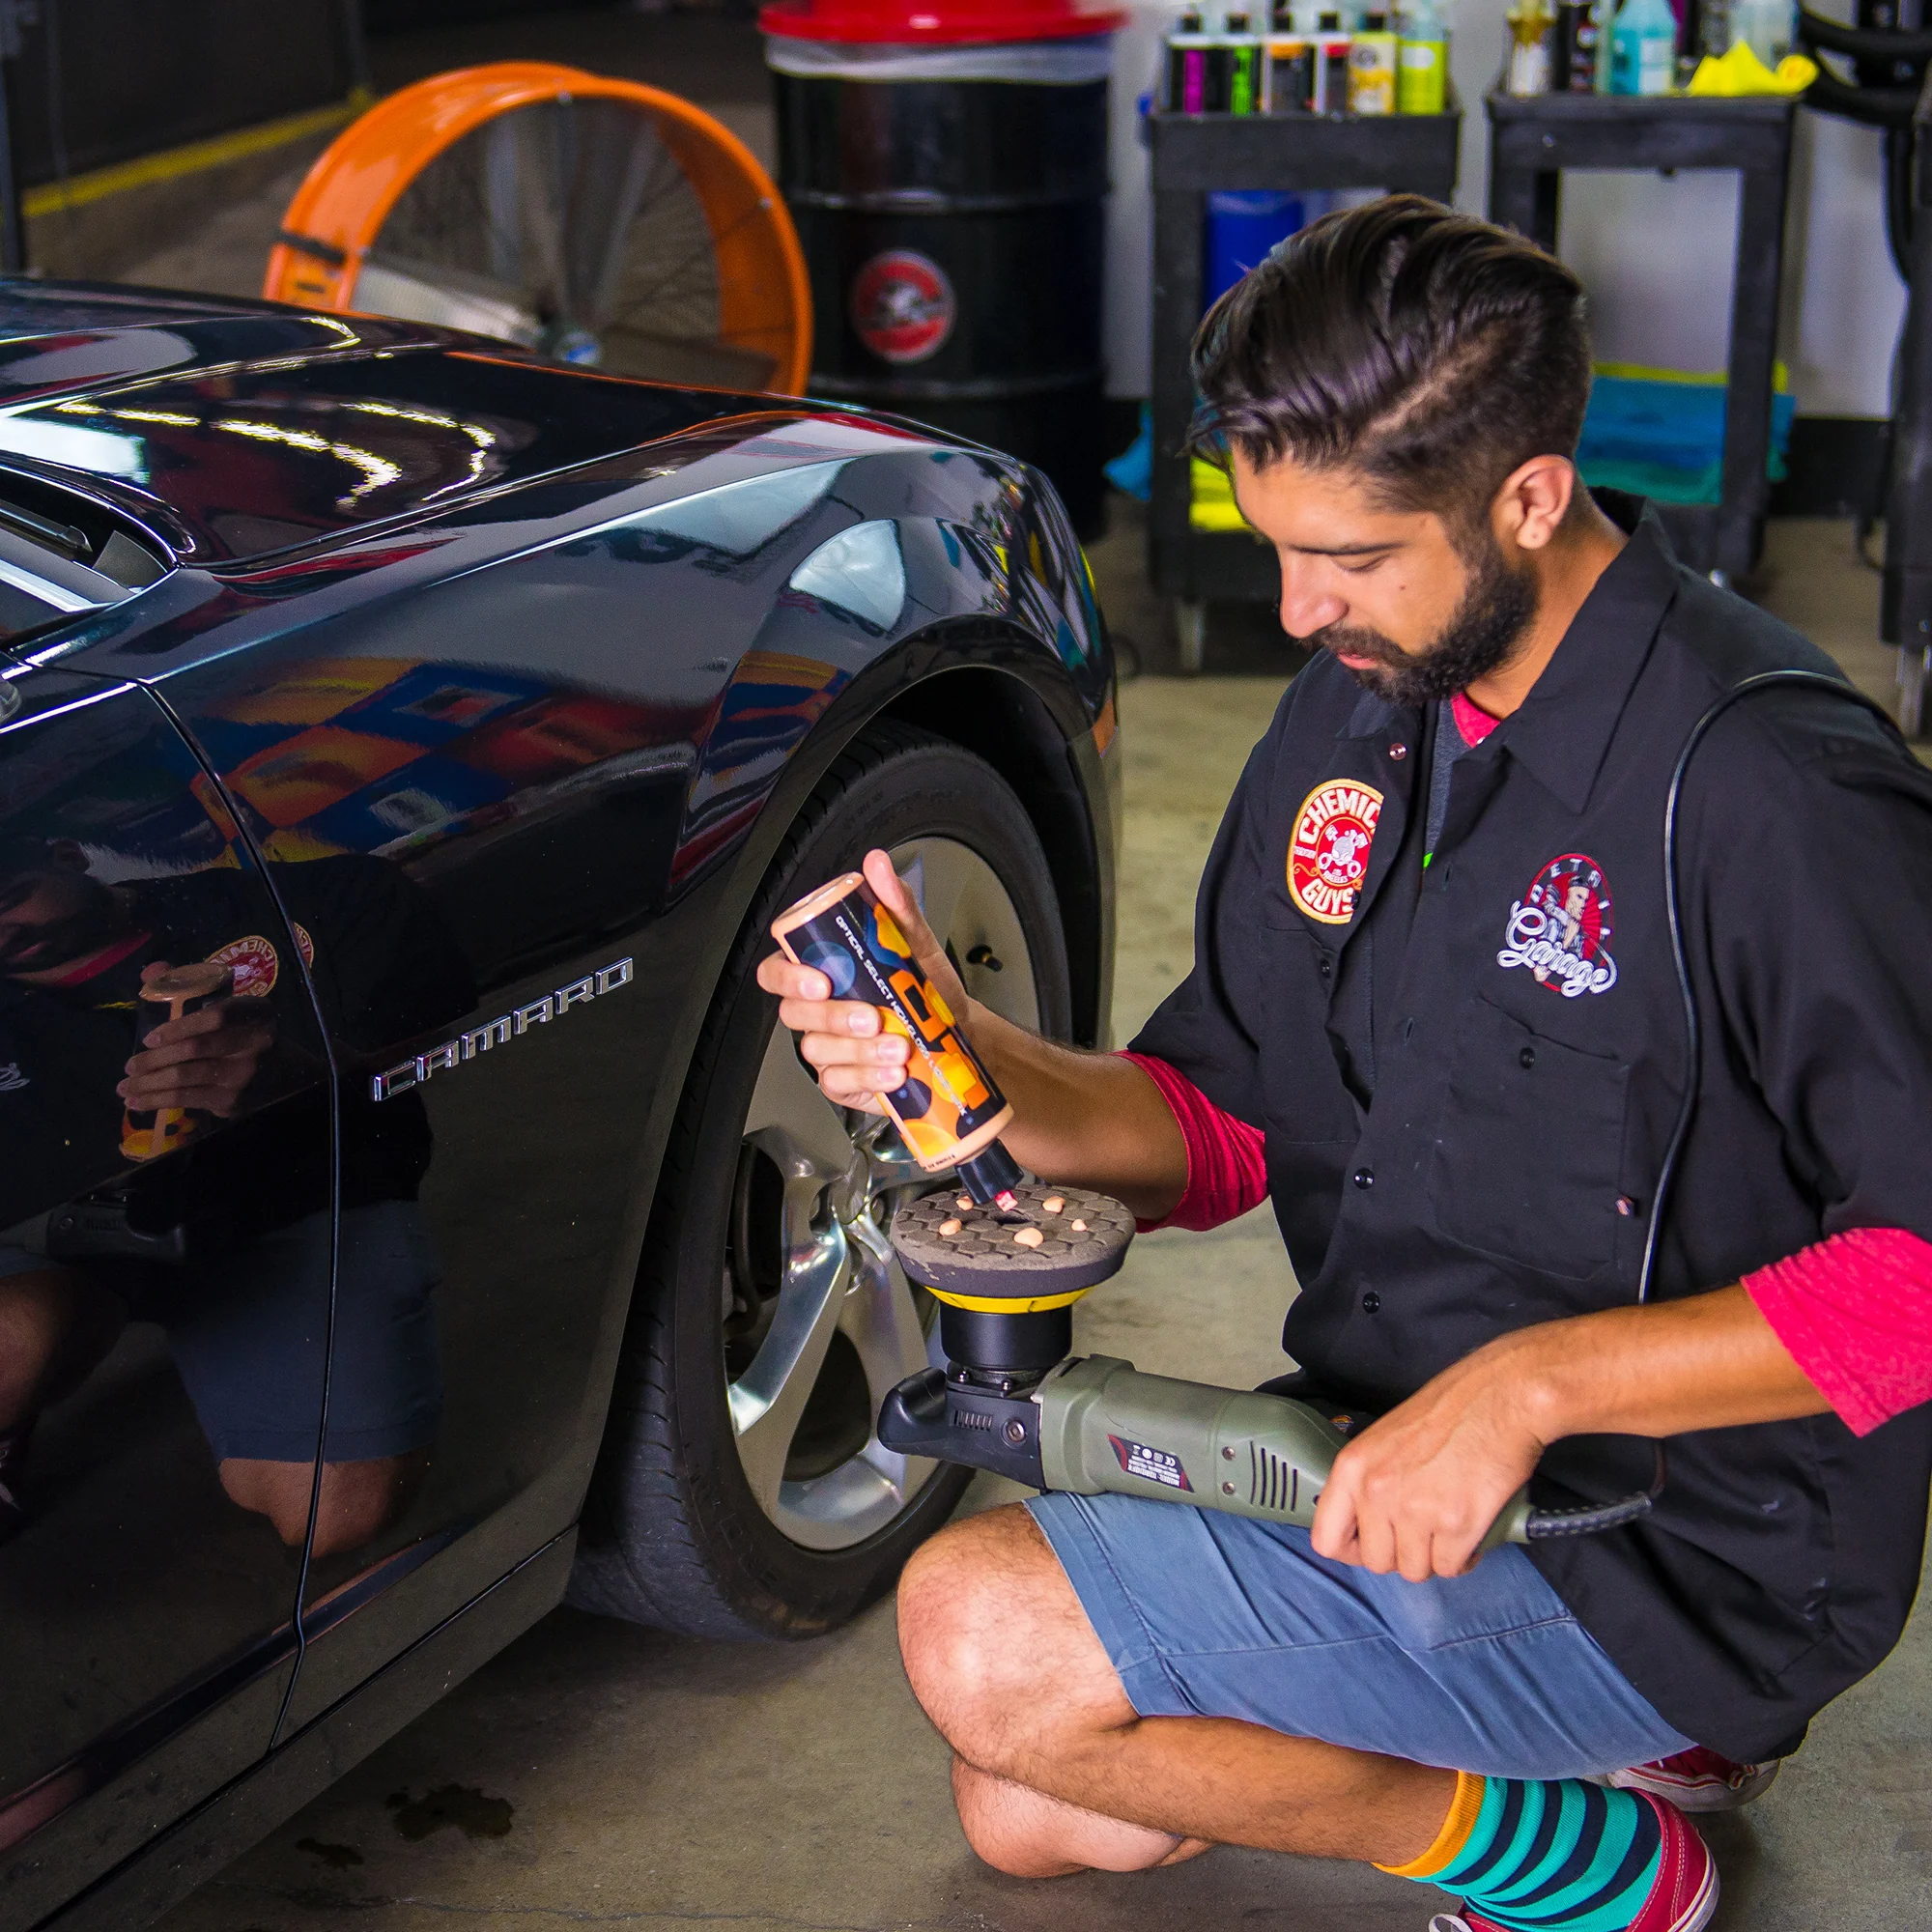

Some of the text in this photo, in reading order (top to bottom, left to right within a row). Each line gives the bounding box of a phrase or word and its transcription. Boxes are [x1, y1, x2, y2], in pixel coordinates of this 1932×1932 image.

[1298, 788, 1381, 844] CHEMIC
[1301, 878, 1354, 915] GUYS
[834, 914, 867, 960] OPTICAL
[862, 957, 895, 1002] SELECT
[903, 1023, 932, 1060] GLOSS
[1497, 899, 1618, 998] Garage
[370, 957, 634, 1101] CAMARO
